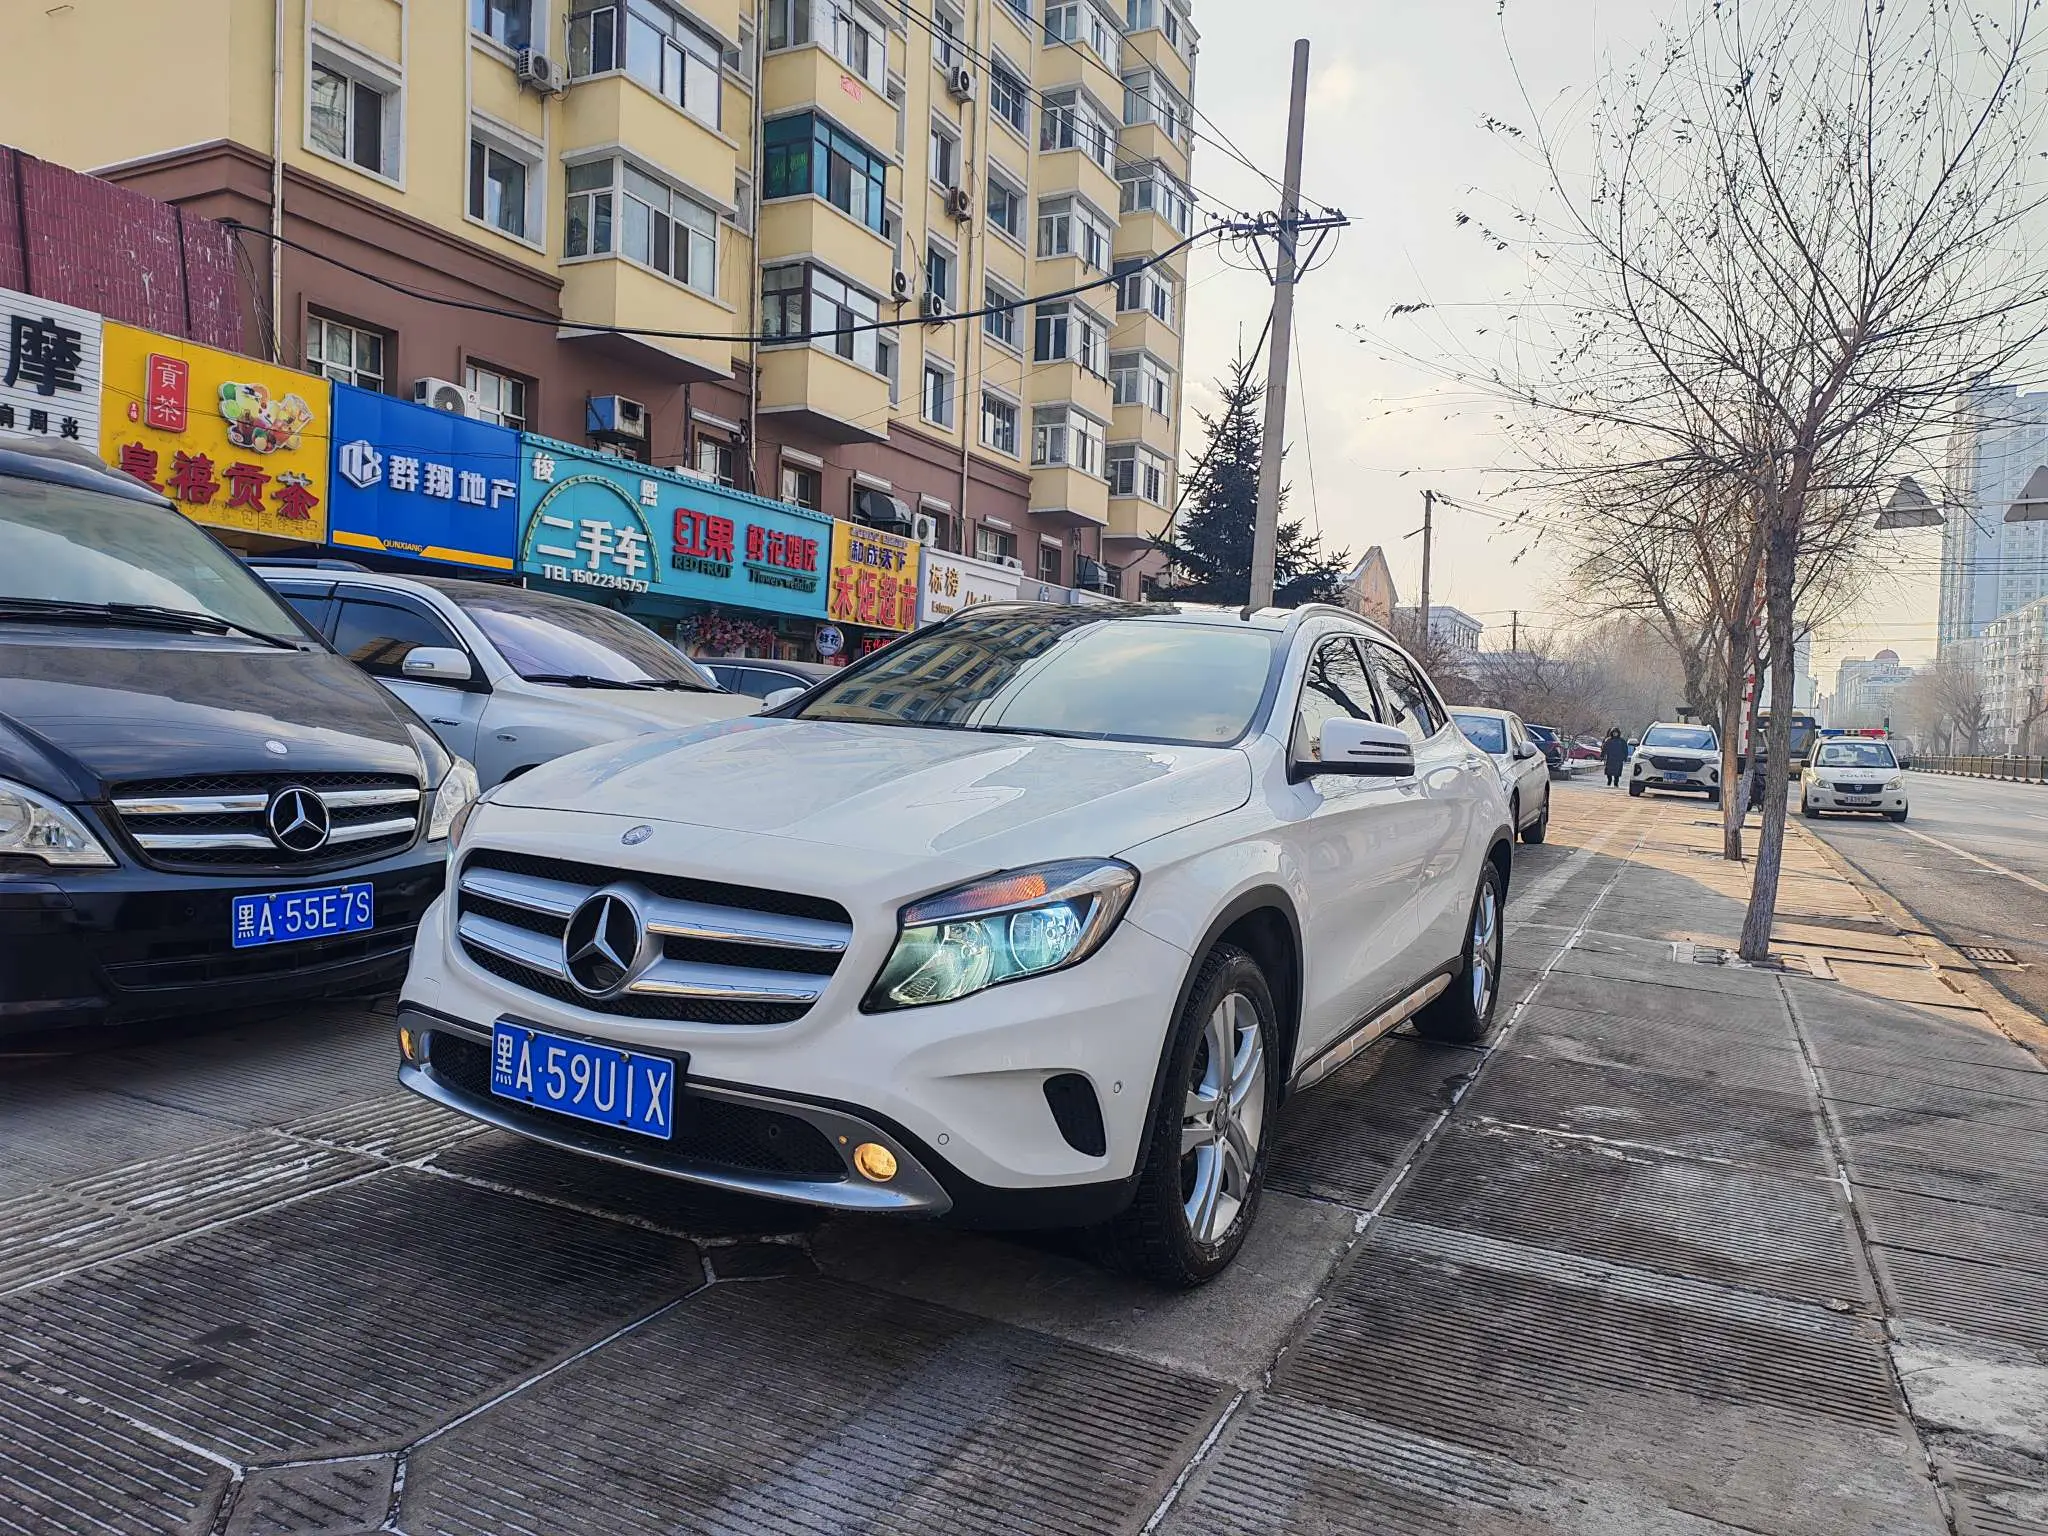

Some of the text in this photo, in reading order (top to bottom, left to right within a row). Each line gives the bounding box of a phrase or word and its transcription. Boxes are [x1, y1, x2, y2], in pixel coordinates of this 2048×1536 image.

[3, 315, 82, 396] 摩
[389, 455, 516, 509] 群翔地产
[383, 539, 424, 552] QUNXIANG
[537, 515, 648, 576] 二手车
[673, 507, 735, 563] 红果
[746, 523, 819, 571] 鲜花婚庆
[543, 563, 649, 593] TEL 15022345757
[673, 555, 733, 578] RED FRUIT
